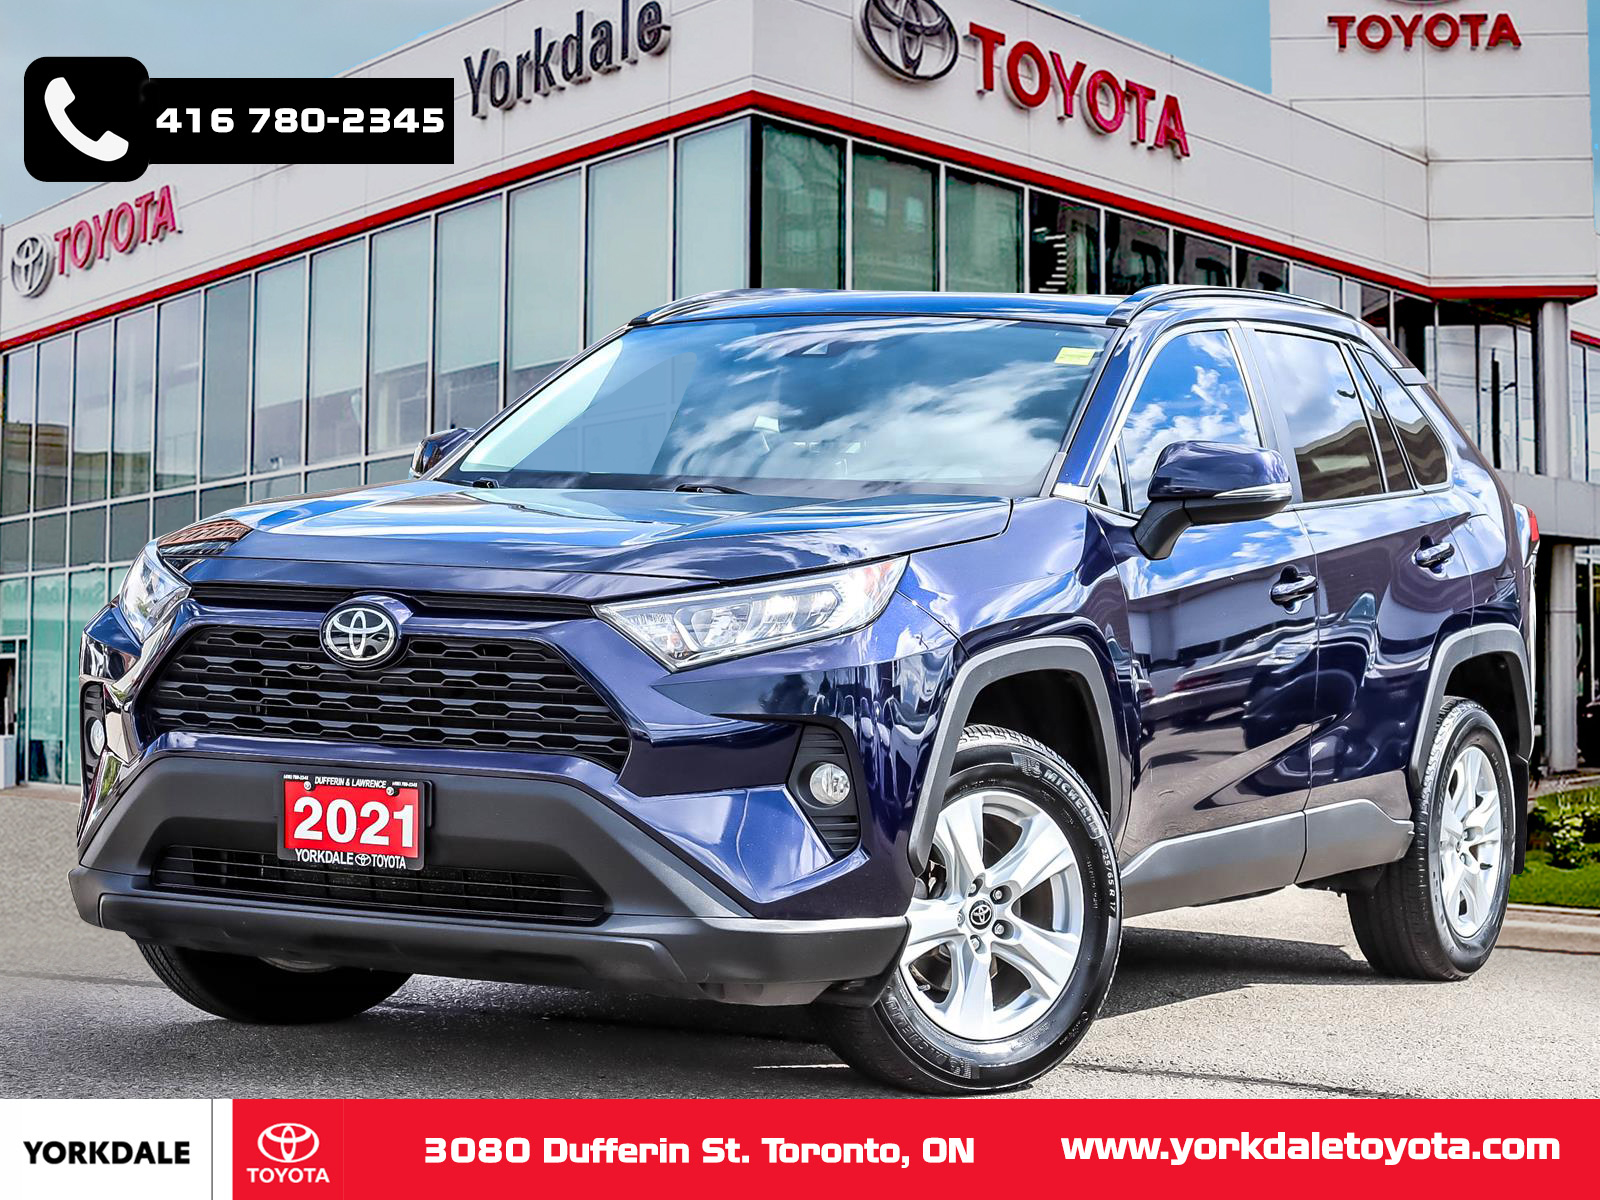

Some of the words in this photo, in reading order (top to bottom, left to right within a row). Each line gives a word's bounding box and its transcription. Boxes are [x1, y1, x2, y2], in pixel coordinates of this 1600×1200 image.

[463, 0, 671, 119] Yorkdale
[1328, 13, 1521, 51] TOYOTA
[969, 22, 1190, 158] TOYOTA
[54, 185, 181, 275] TOYOTA
[314, 776, 345, 786] DUFFERIN
[351, 778, 387, 789] LAWRENCE
[1043, 769, 1102, 837] MICHELIN
[293, 796, 414, 848] 2021
[294, 848, 354, 866] YORKDALE
[371, 853, 407, 869] TOYOTA
[1101, 847, 1116, 885] 225/65
[1109, 900, 1116, 912] 17
